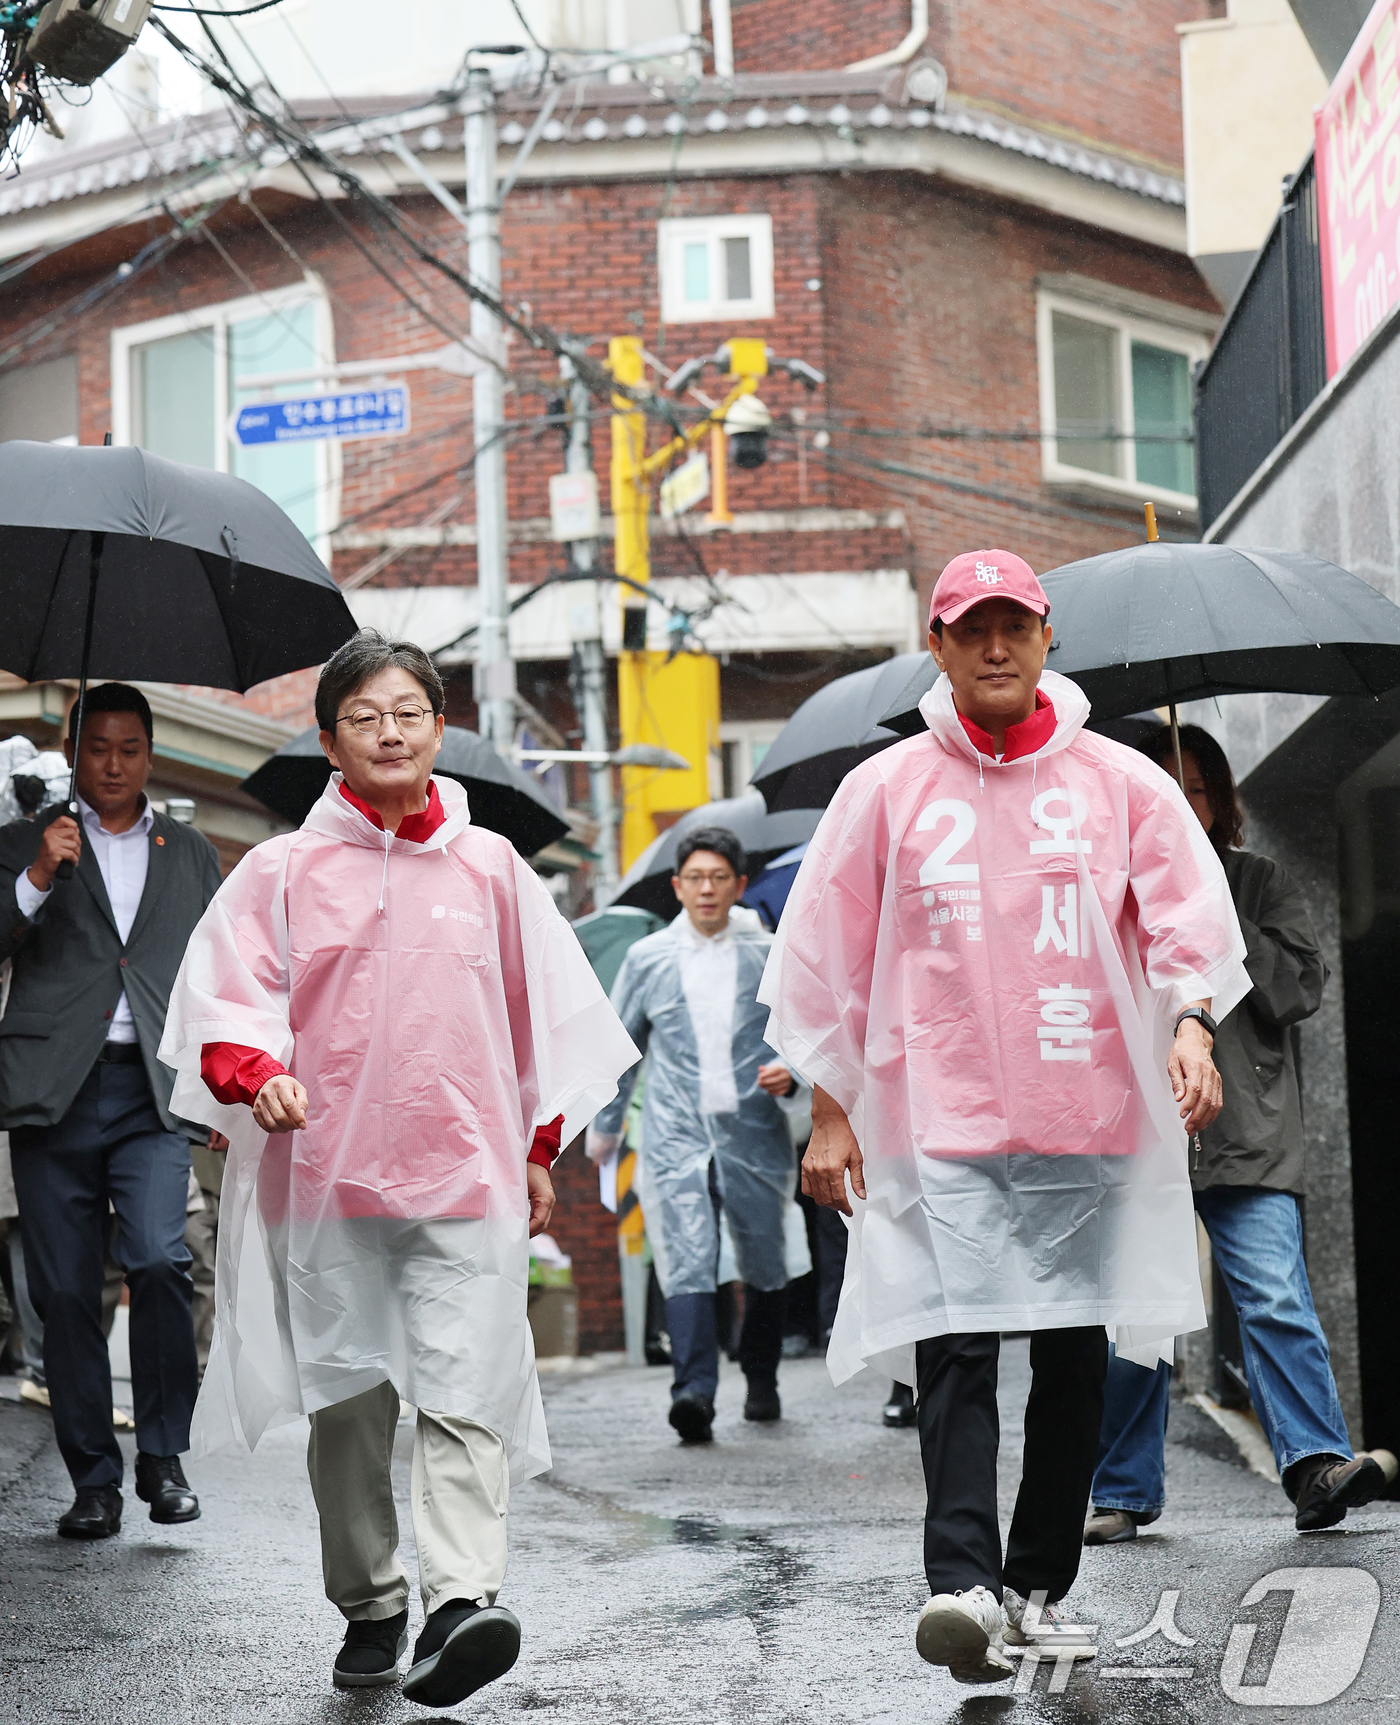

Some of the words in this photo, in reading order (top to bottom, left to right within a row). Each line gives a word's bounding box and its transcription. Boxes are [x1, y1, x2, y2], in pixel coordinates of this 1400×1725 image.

[915, 798, 980, 888] 2
[928, 905, 982, 926] 서울시장
[937, 889, 981, 902] 국민의힘
[1029, 787, 1094, 1061] 오세훈
